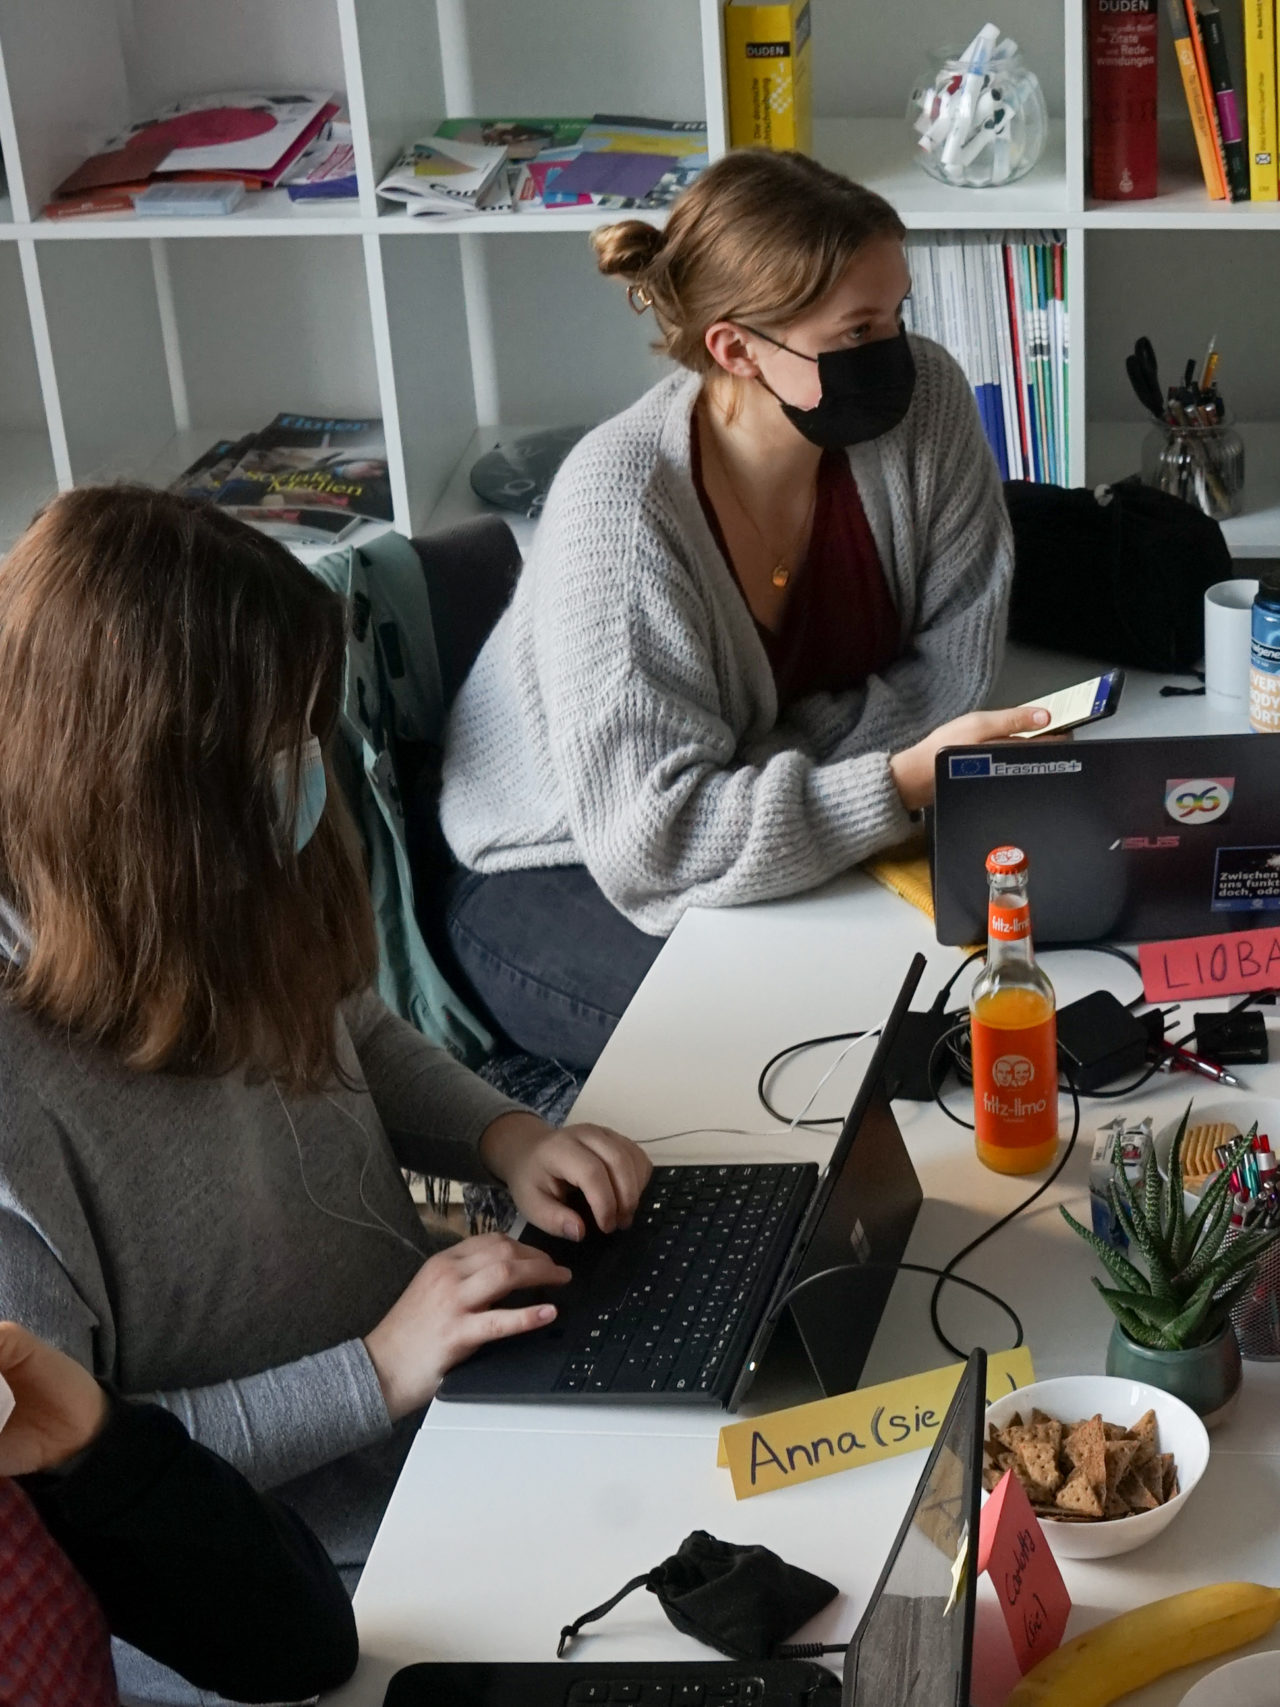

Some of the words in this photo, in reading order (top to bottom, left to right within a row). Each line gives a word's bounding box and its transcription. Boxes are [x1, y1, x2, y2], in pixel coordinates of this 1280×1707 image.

[1098, 0, 1150, 12] DUDEN
[746, 45, 785, 57] DUDEN
[267, 478, 363, 496] Medien
[994, 760, 1081, 776] Erasmus+
[1175, 785, 1221, 818] 96
[1109, 835, 1181, 851] ASUS
[1219, 871, 1279, 881] Zwischen
[1218, 888, 1253, 897] doch,
[1219, 881, 1242, 889] uns
[983, 1091, 1047, 1117] fritz-limo
[750, 1430, 867, 1486] Anna
